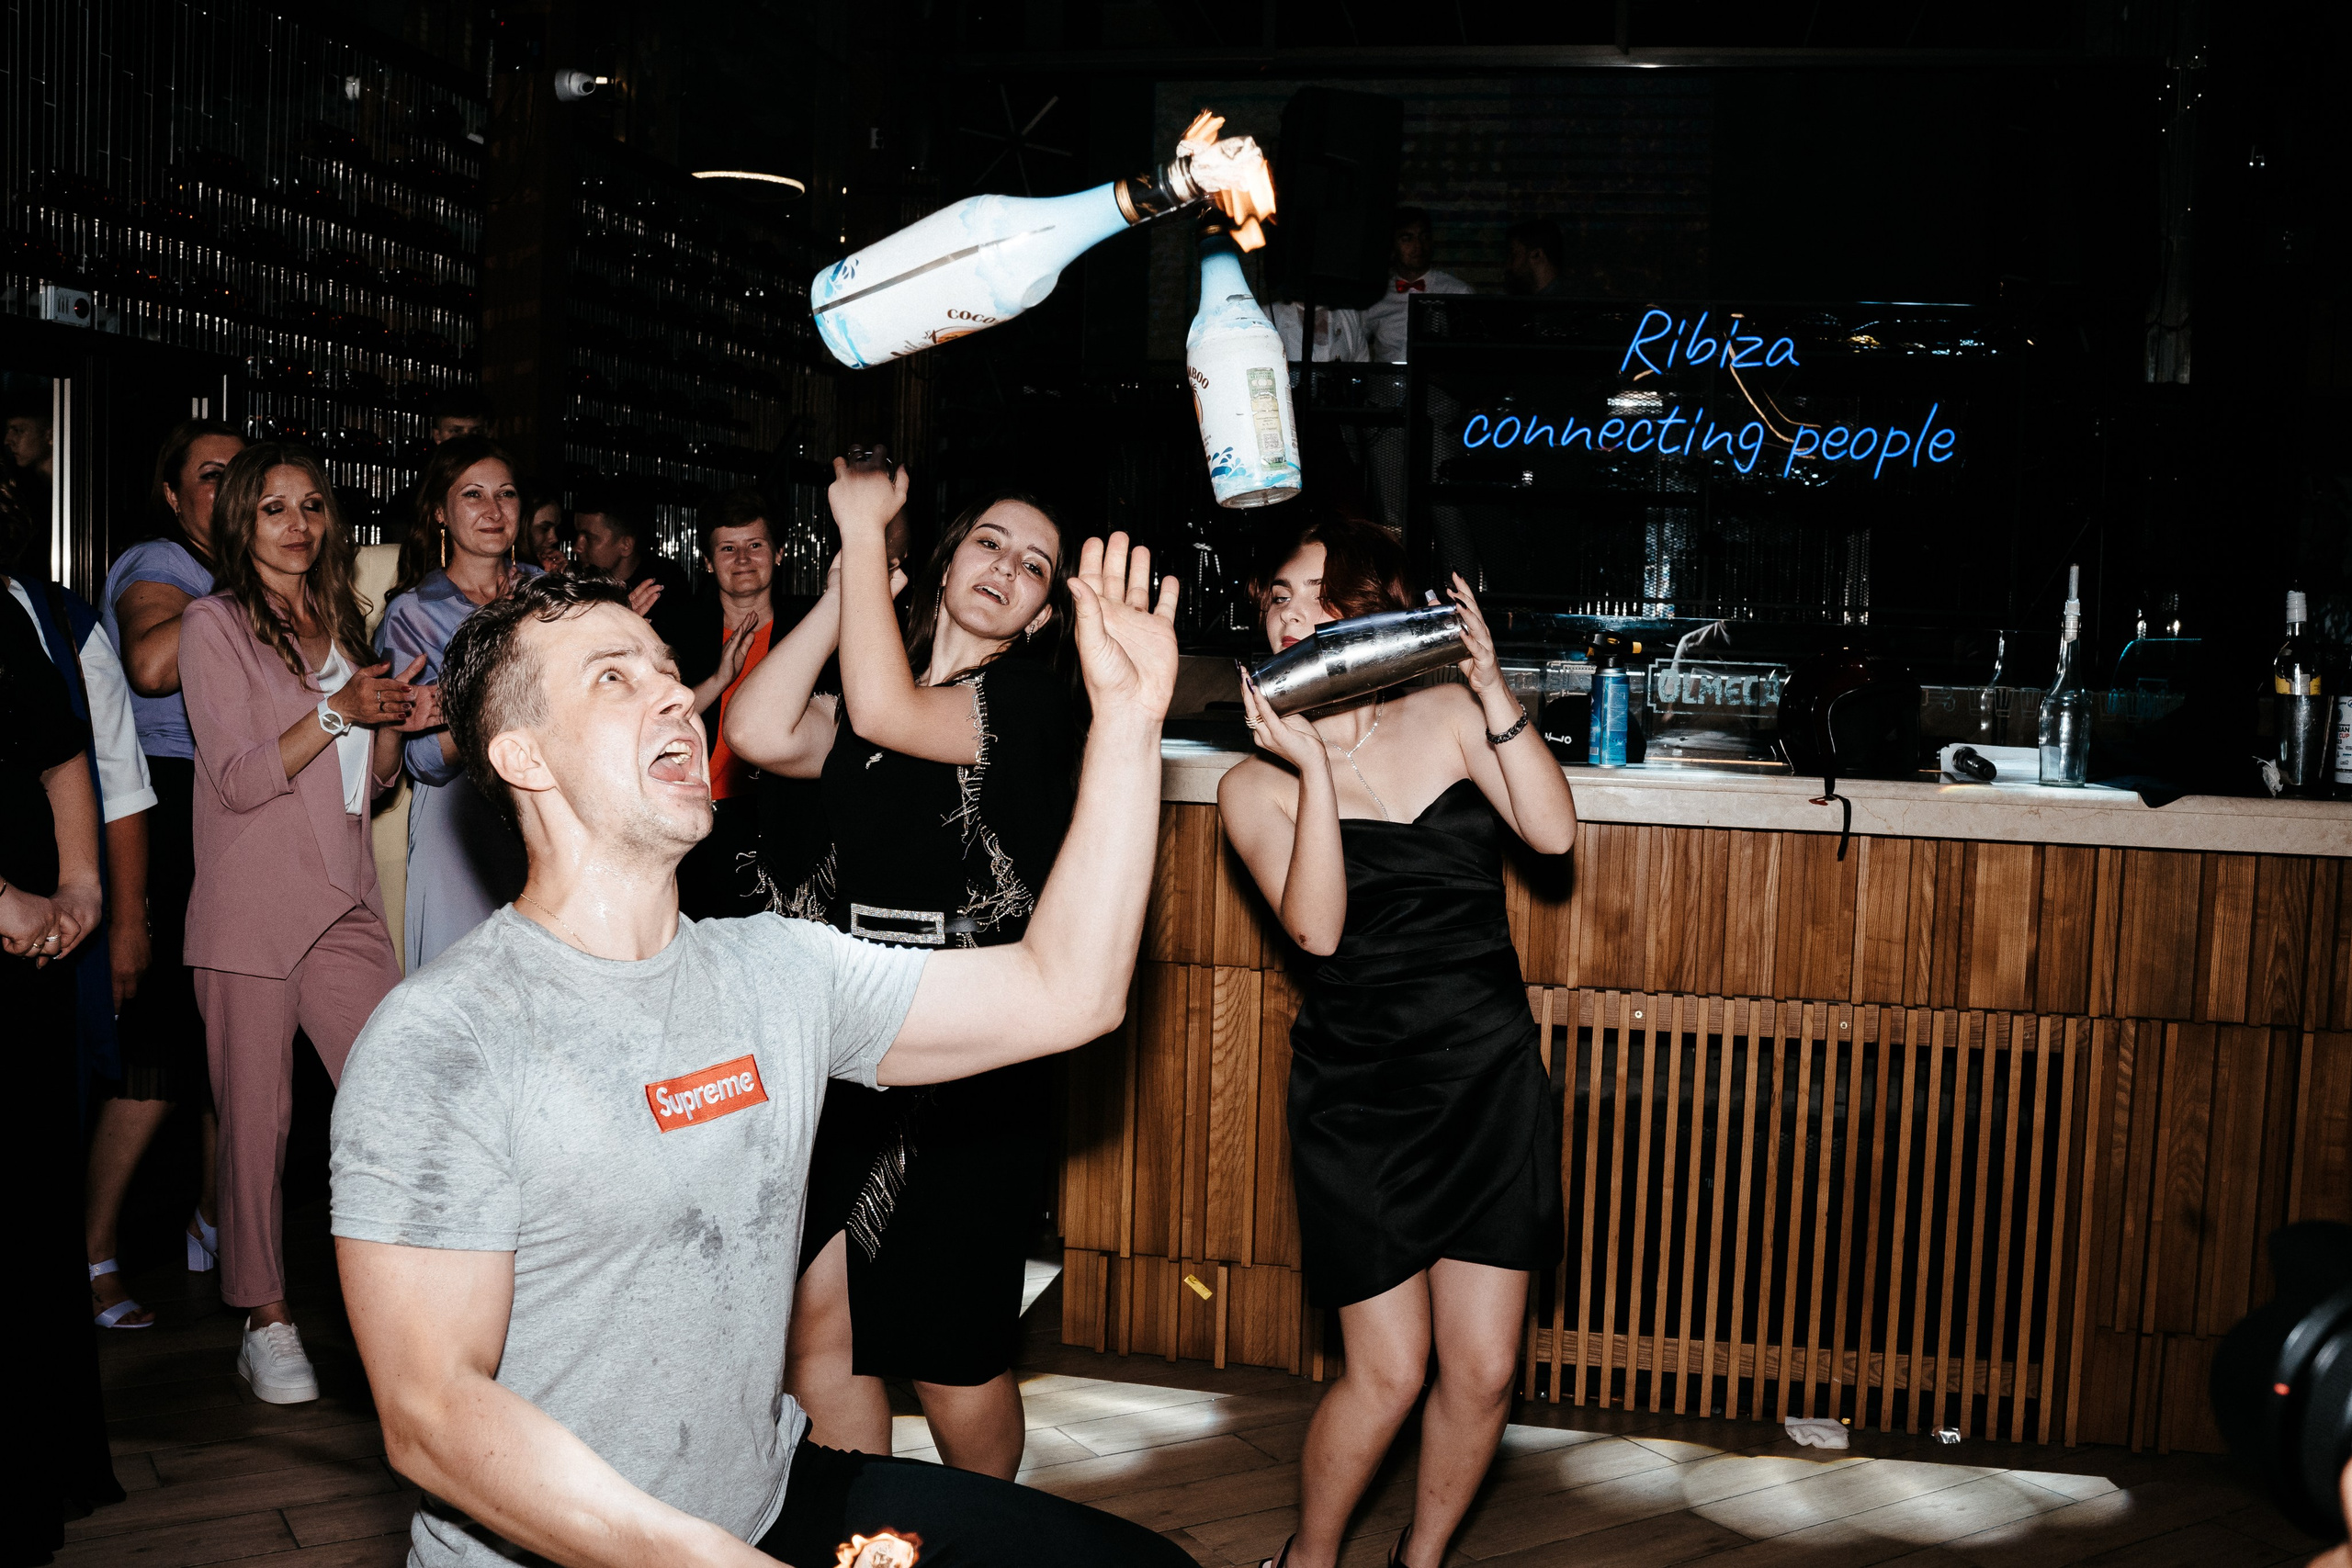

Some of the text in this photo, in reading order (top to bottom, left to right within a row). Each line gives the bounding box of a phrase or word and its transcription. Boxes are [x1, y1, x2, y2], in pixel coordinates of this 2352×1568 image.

[947, 309, 997, 323] COCO
[1621, 310, 1800, 375] Ribiza
[1463, 402, 1956, 479] connecting people
[656, 1071, 755, 1121] Supreme
